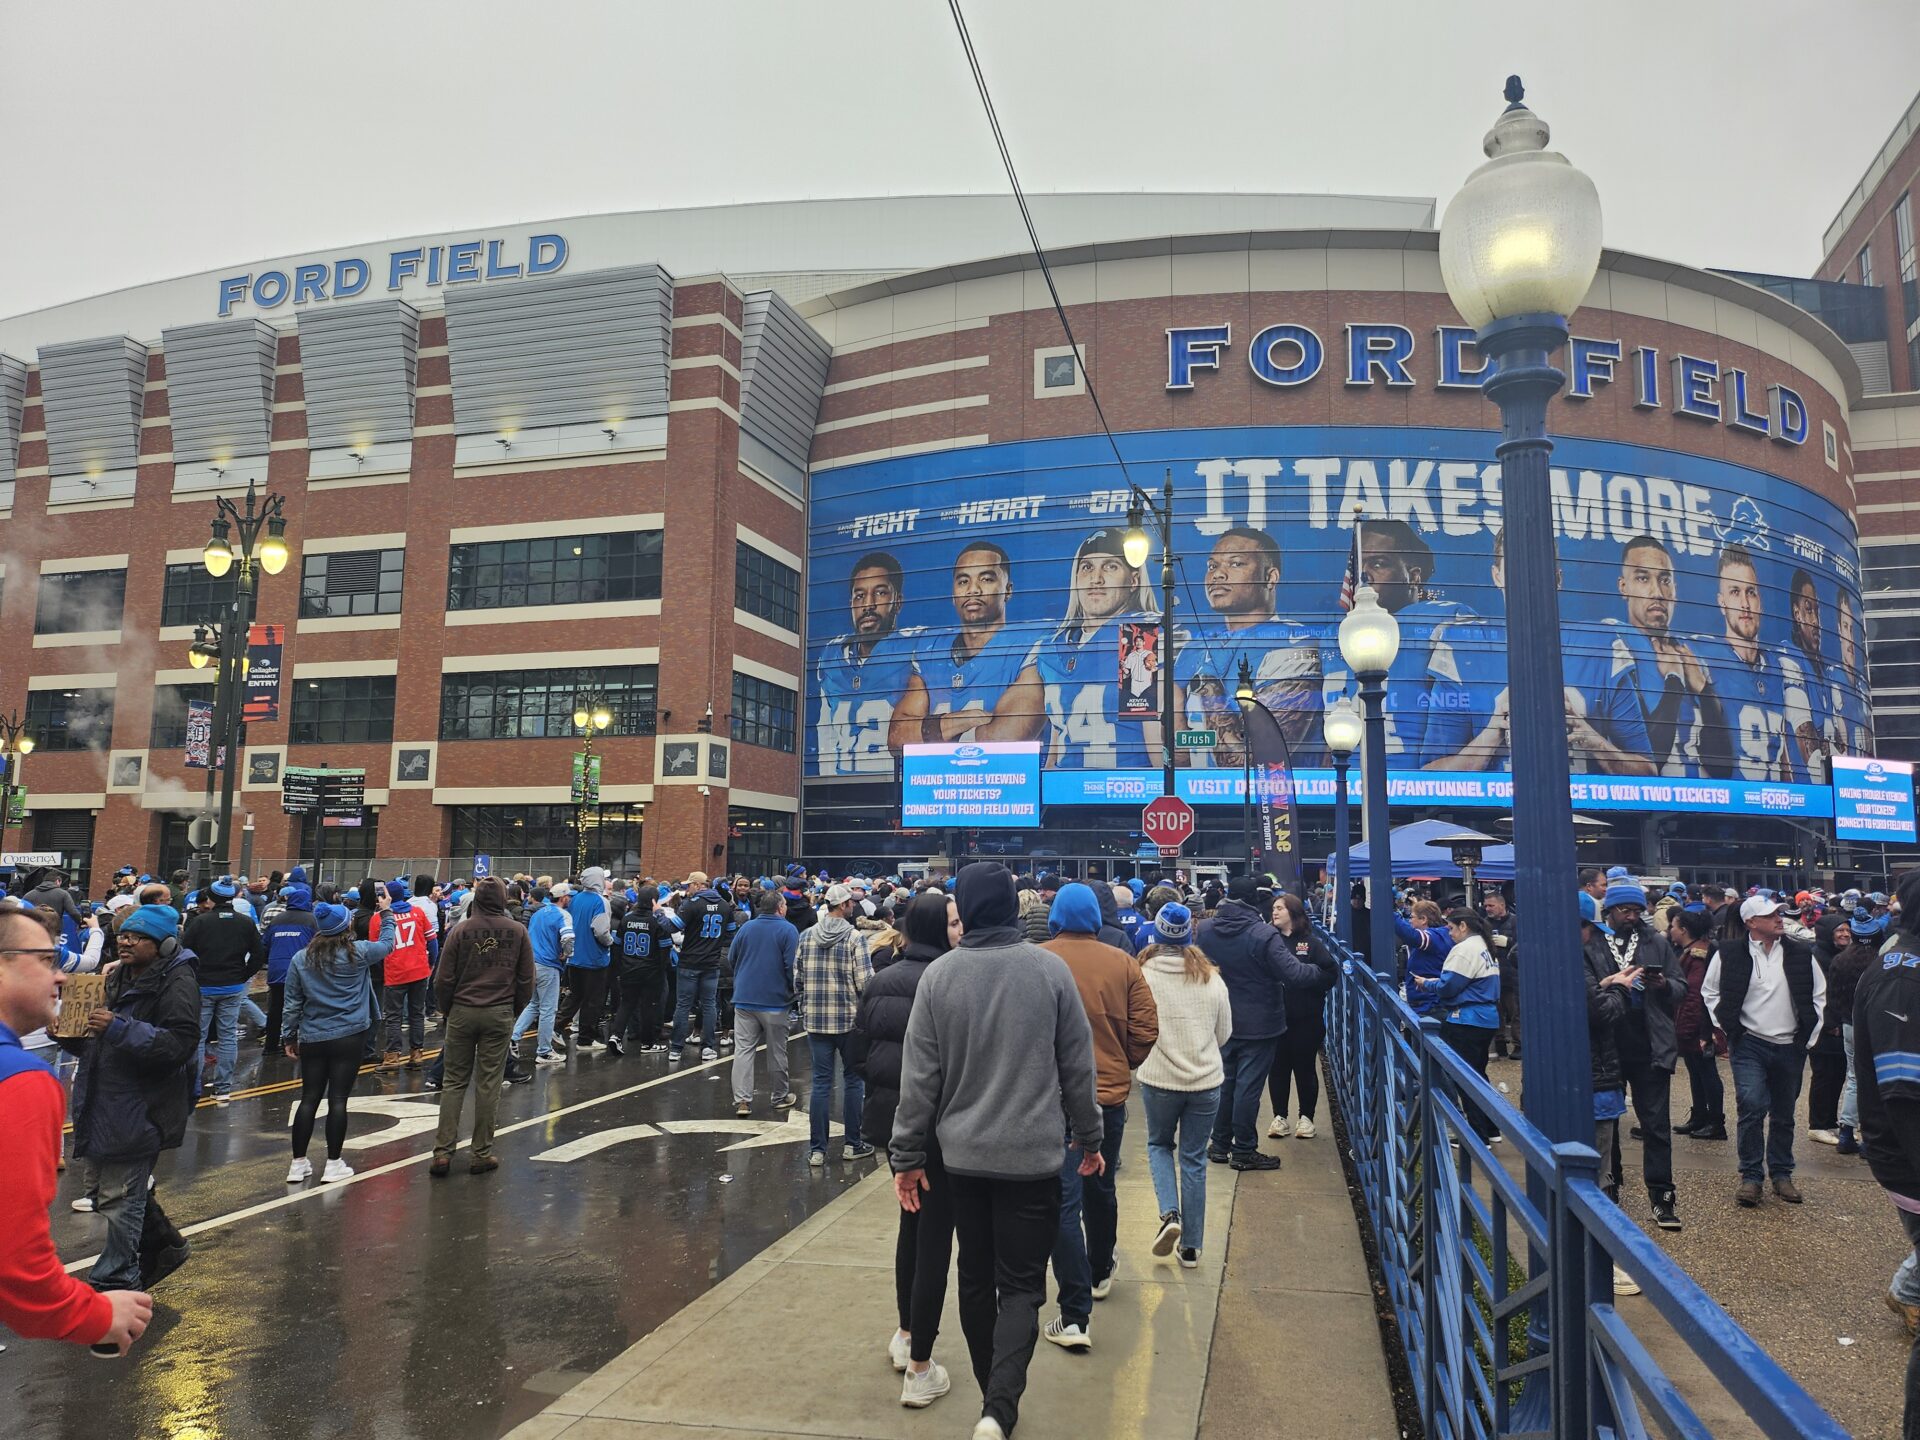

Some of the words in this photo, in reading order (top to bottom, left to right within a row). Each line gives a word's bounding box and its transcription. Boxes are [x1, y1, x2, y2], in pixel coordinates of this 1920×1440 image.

[217, 257, 371, 317] FORD
[388, 233, 569, 291] FIELD
[1164, 322, 1497, 390] FORD
[1563, 335, 1809, 446] FIELD
[958, 495, 1046, 525] HEART
[1194, 457, 1283, 535] IT
[1292, 458, 1504, 536] TAKES
[1549, 469, 1716, 556] MORE
[852, 508, 921, 539] FIGHT
[1181, 733, 1210, 745] Brush
[910, 775, 943, 786] HAVING
[945, 774, 983, 785] TROUBLE
[985, 774, 1026, 785] VIEWING
[1106, 781, 1145, 794] FORD
[1188, 780, 1231, 795] VISIT
[933, 789, 957, 800] YOUR
[959, 789, 1001, 800] TICKETS?
[1589, 784, 1608, 800] TO
[1610, 785, 1640, 801] WIN
[1641, 786, 1672, 802] TWO
[1673, 787, 1731, 804] TICKETS!
[1761, 792, 1790, 806] FORD
[904, 804, 944, 815] CONNECT
[945, 804, 957, 815] TO
[958, 804, 982, 815] FORD
[984, 804, 1010, 815] FIELD
[1011, 804, 1035, 815] WIFI
[1146, 811, 1190, 830] STOP
[1160, 848, 1169, 856] ALL
[627, 921, 650, 930] CAMPBELL
[700, 913, 723, 938] 16
[394, 920, 416, 950] 17
[624, 931, 651, 957] 89
[1883, 952, 1920, 969] 97
